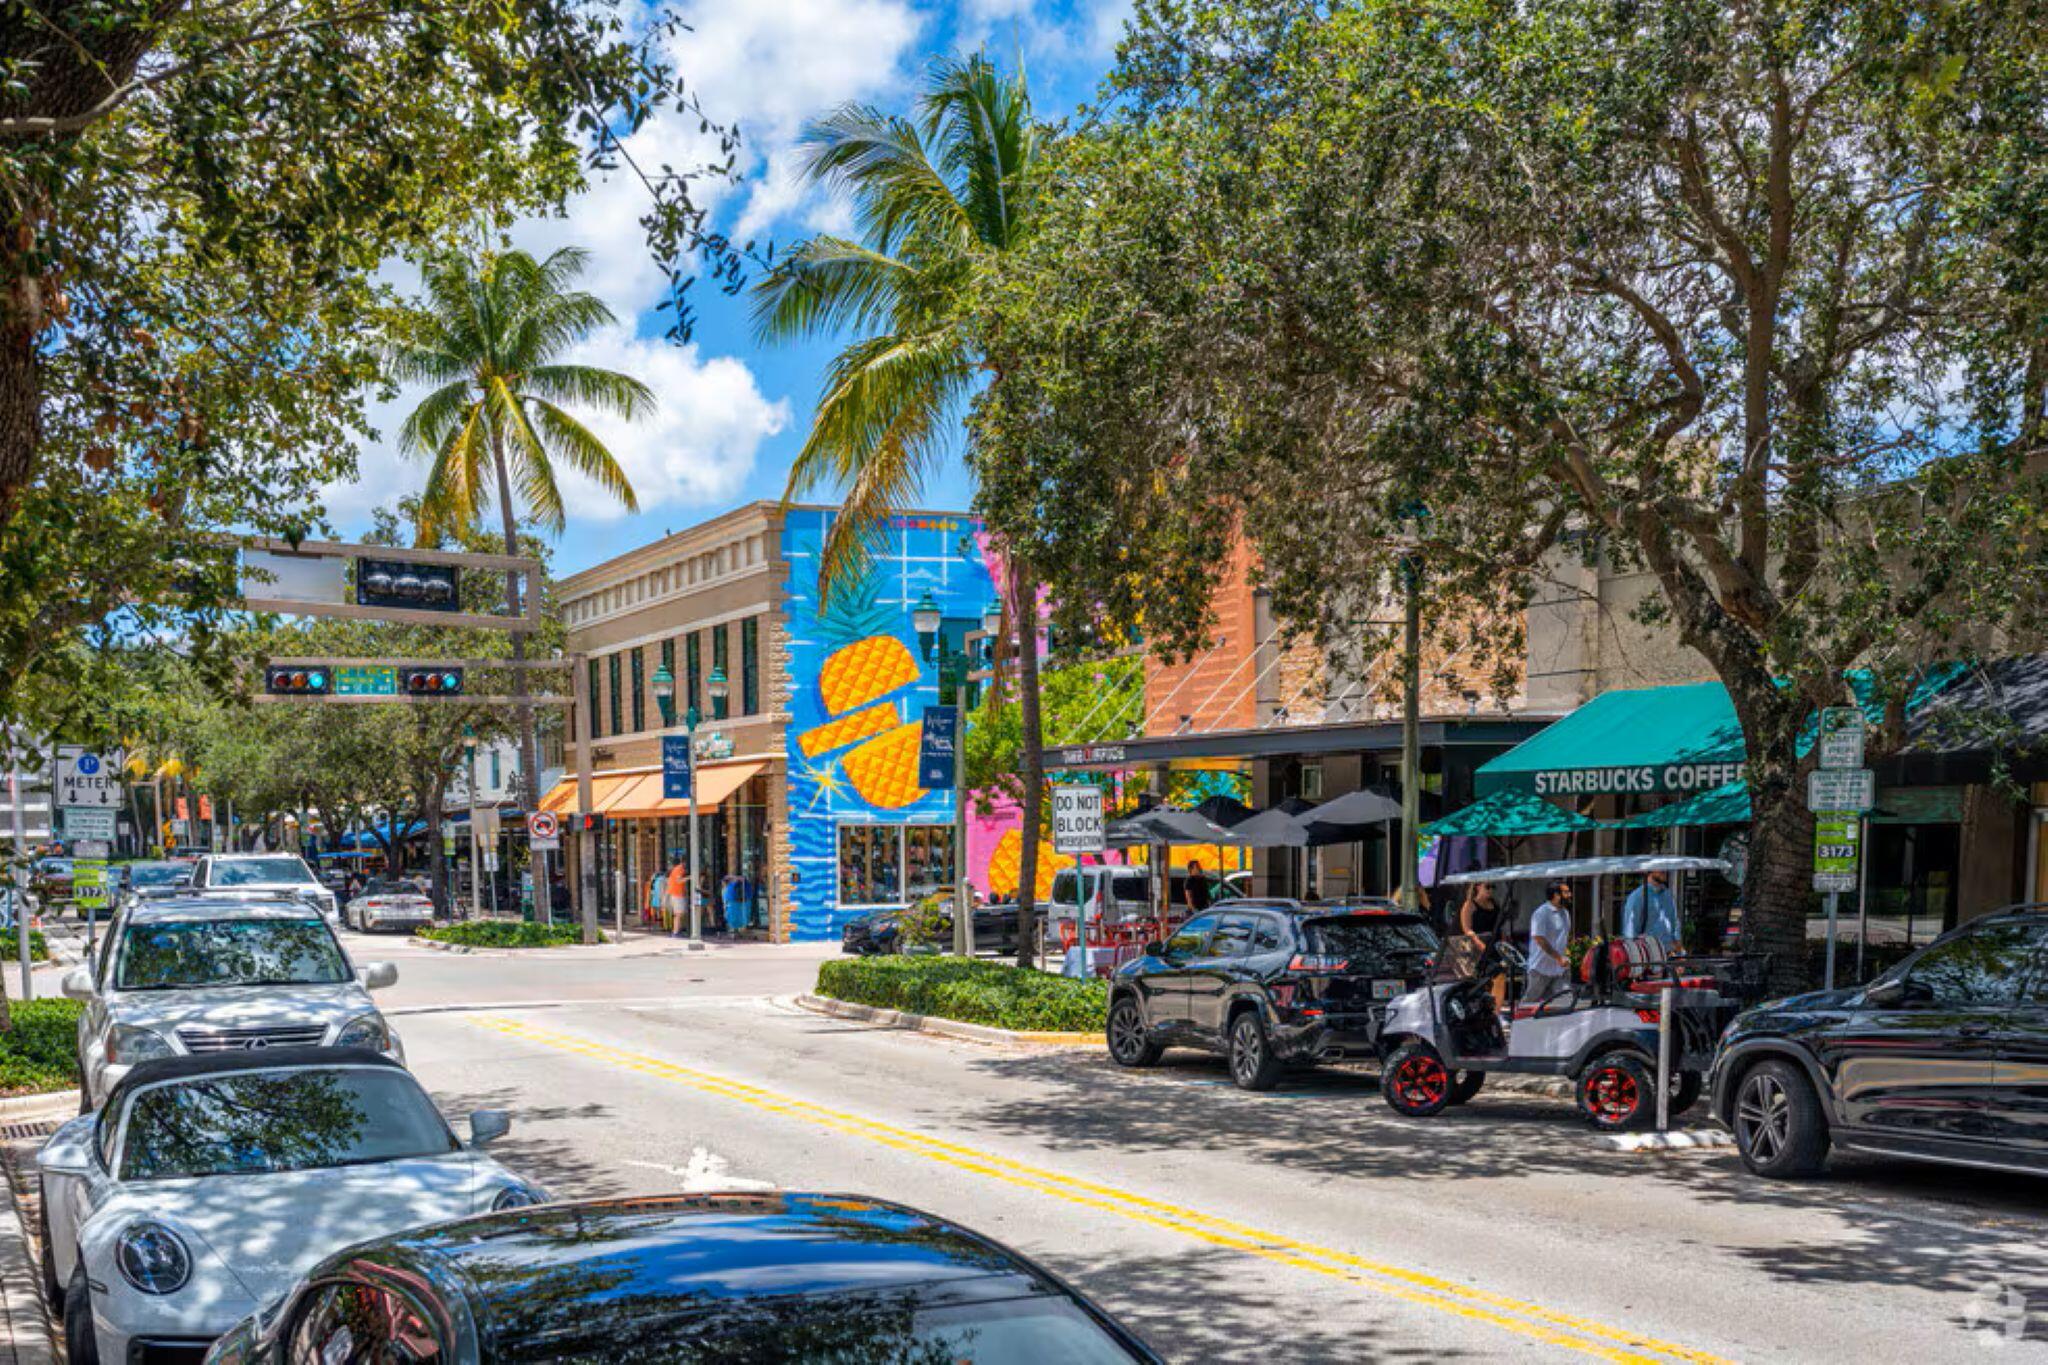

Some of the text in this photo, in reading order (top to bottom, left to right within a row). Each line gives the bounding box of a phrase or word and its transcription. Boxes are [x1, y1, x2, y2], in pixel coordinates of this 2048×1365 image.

[63, 776, 114, 789] METER
[1535, 767, 1655, 794] STARBUCKS
[1056, 794, 1100, 811] DO NOT
[1058, 816, 1102, 833] BLOCK
[1820, 845, 1854, 857] 3173
